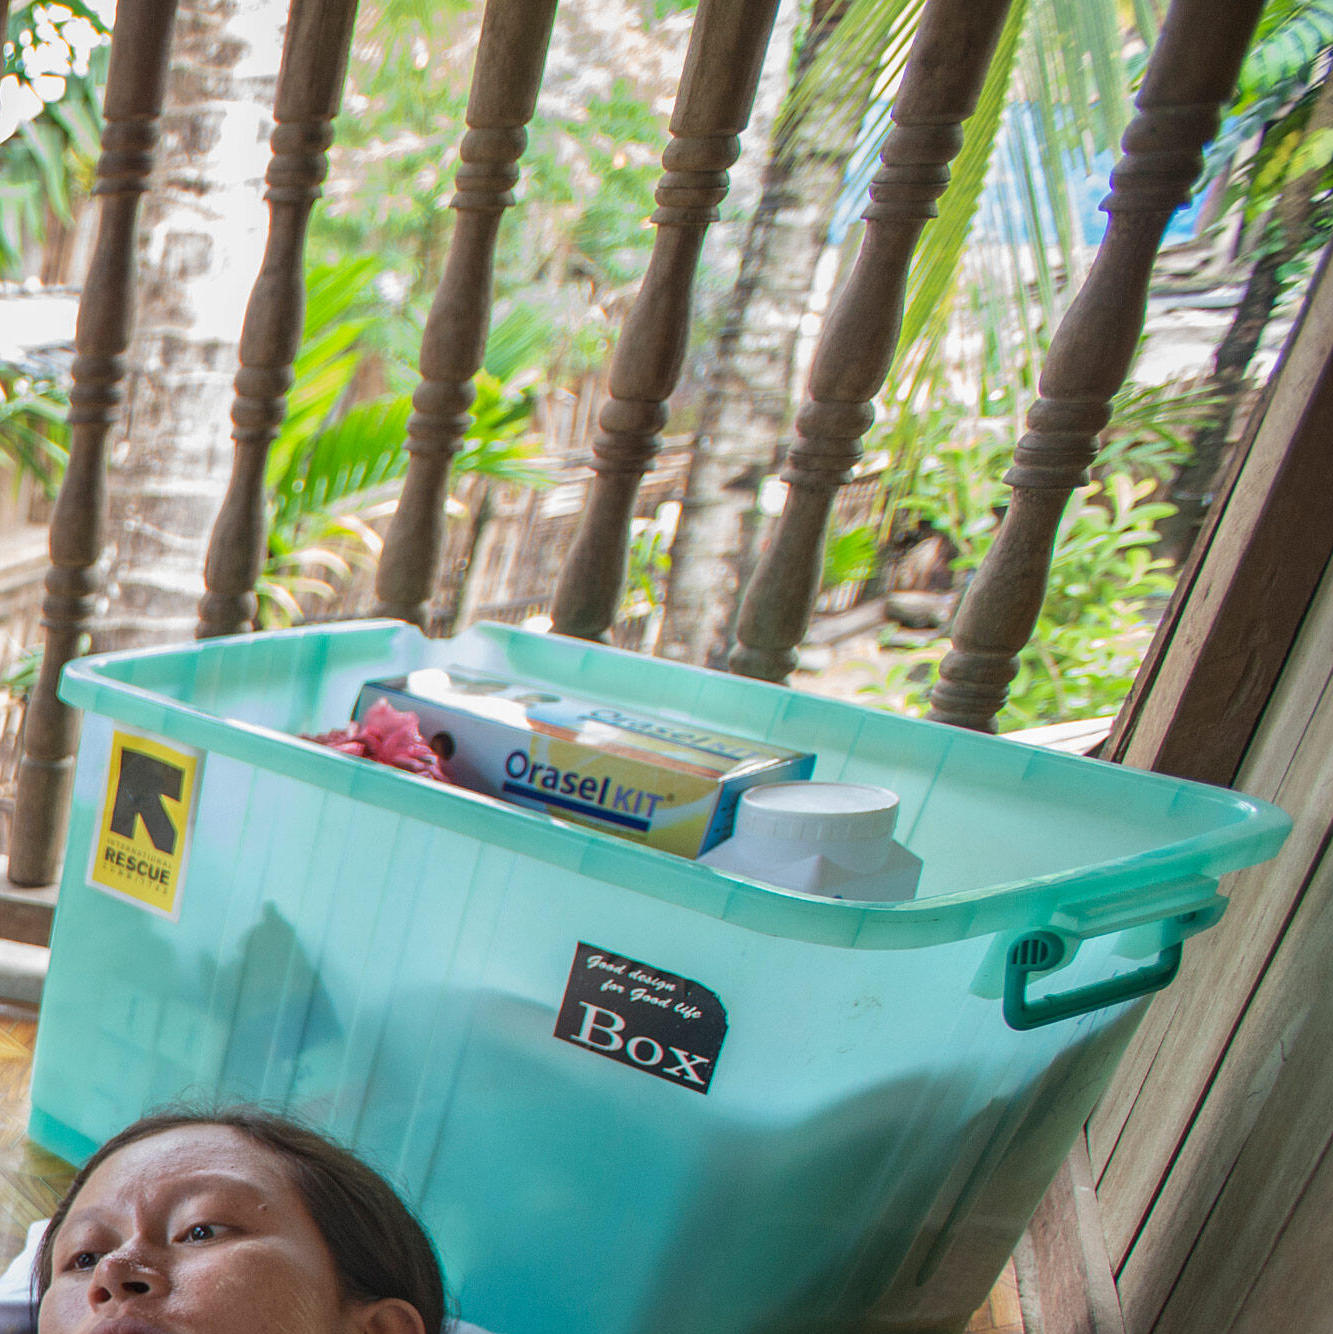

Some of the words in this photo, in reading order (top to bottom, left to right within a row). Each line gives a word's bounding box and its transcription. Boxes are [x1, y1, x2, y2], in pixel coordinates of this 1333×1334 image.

[590, 710, 708, 742] Orasel
[504, 749, 611, 805] Orasel
[612, 784, 665, 818] KIT
[104, 846, 171, 885] RESCUE
[586, 955, 626, 975] Good
[628, 969, 678, 993] design
[599, 979, 626, 994] for
[629, 987, 670, 1009] Good
[673, 1002, 702, 1020] life
